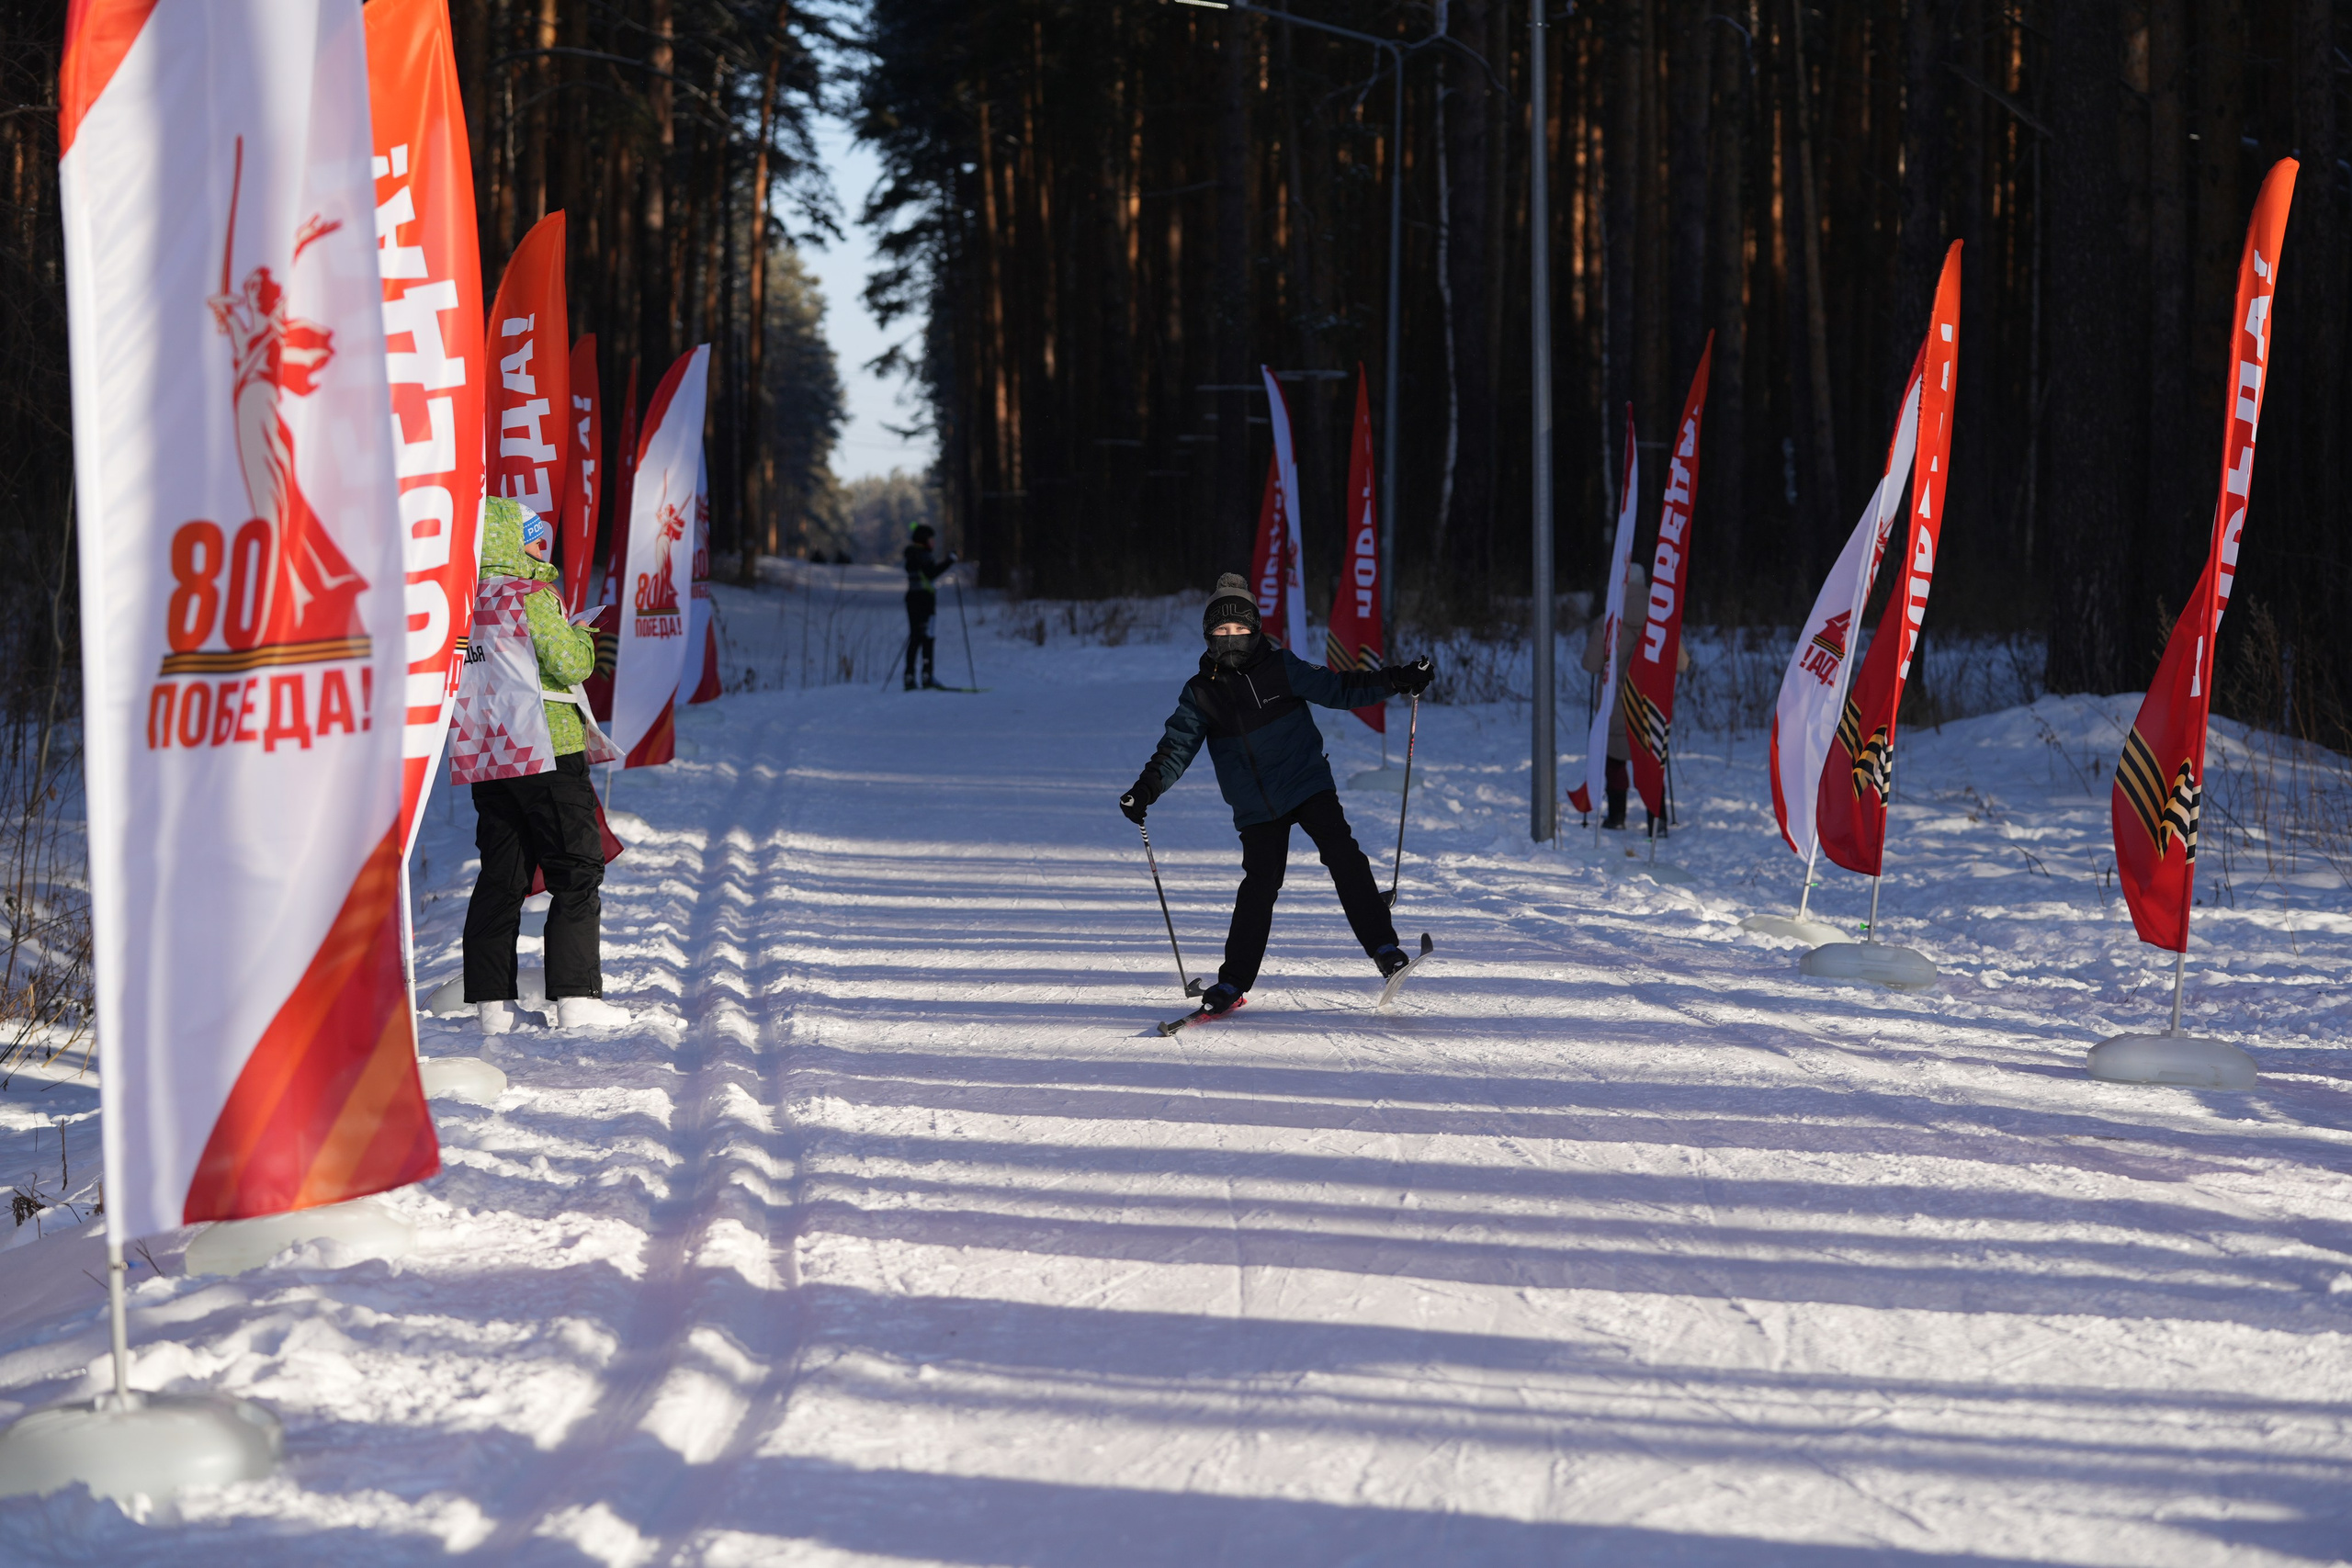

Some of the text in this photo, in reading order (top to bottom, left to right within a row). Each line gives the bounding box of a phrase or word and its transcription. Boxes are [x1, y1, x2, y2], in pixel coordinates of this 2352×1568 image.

[166, 517, 273, 653] 80
[635, 572, 661, 610] 80
[635, 616, 683, 640] ПОБЕДА!
[147, 665, 373, 752] ПОБЕДА!
